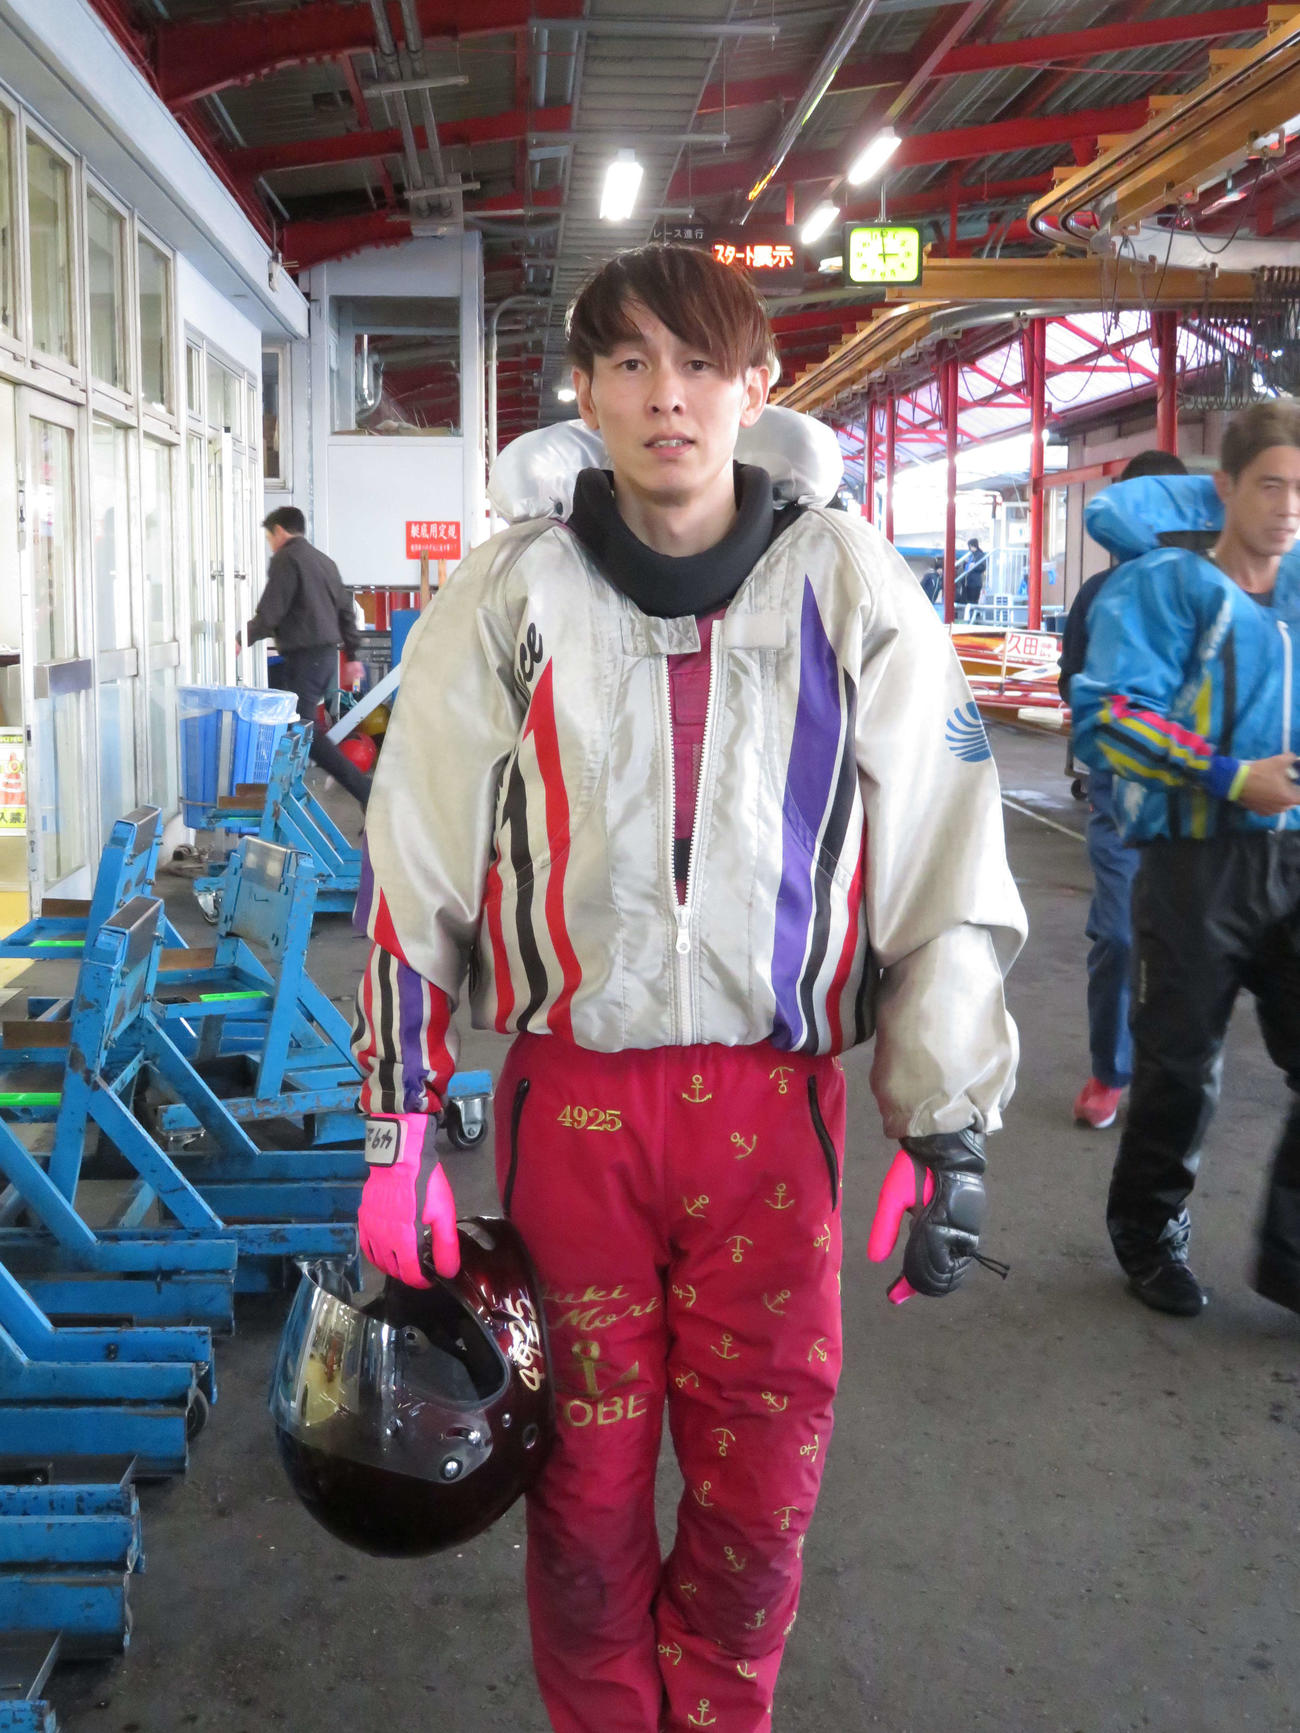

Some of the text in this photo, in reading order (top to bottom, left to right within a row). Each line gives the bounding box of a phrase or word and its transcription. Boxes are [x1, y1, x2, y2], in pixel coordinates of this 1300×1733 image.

[653, 228, 704, 239] レース進行
[714, 244, 794, 267] スタート展示
[557, 1104, 622, 1131] 4925
[542, 1285, 630, 1303] uki
[547, 1297, 661, 1330] Mori
